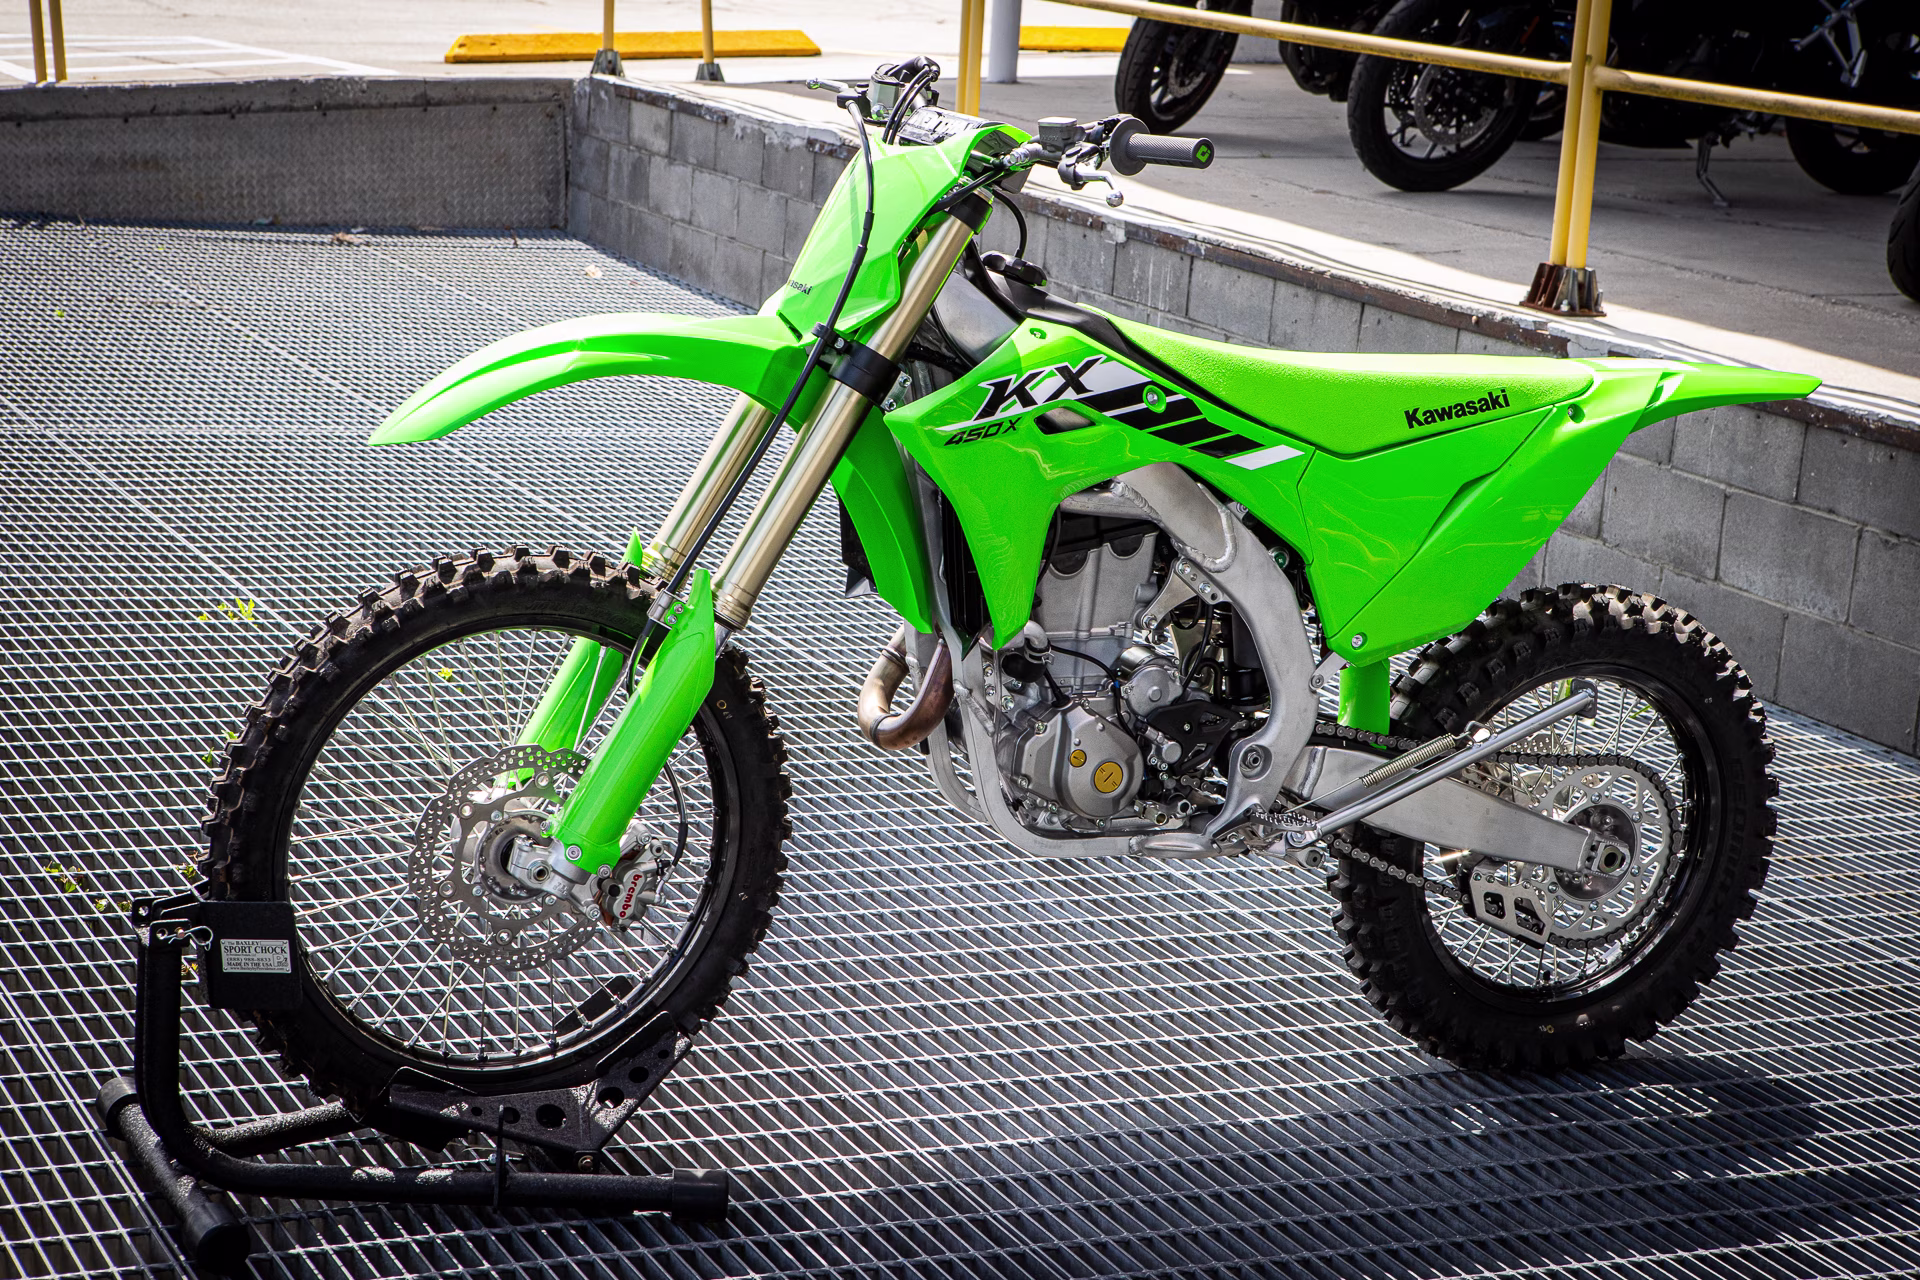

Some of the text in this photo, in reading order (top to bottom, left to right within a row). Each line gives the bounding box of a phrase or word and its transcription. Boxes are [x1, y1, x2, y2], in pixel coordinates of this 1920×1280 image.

[973, 356, 1103, 422] KX
[1404, 389, 1510, 429] Kawasaki
[619, 874, 643, 918] brembo
[224, 946, 287, 954] SPORT CHOCK
